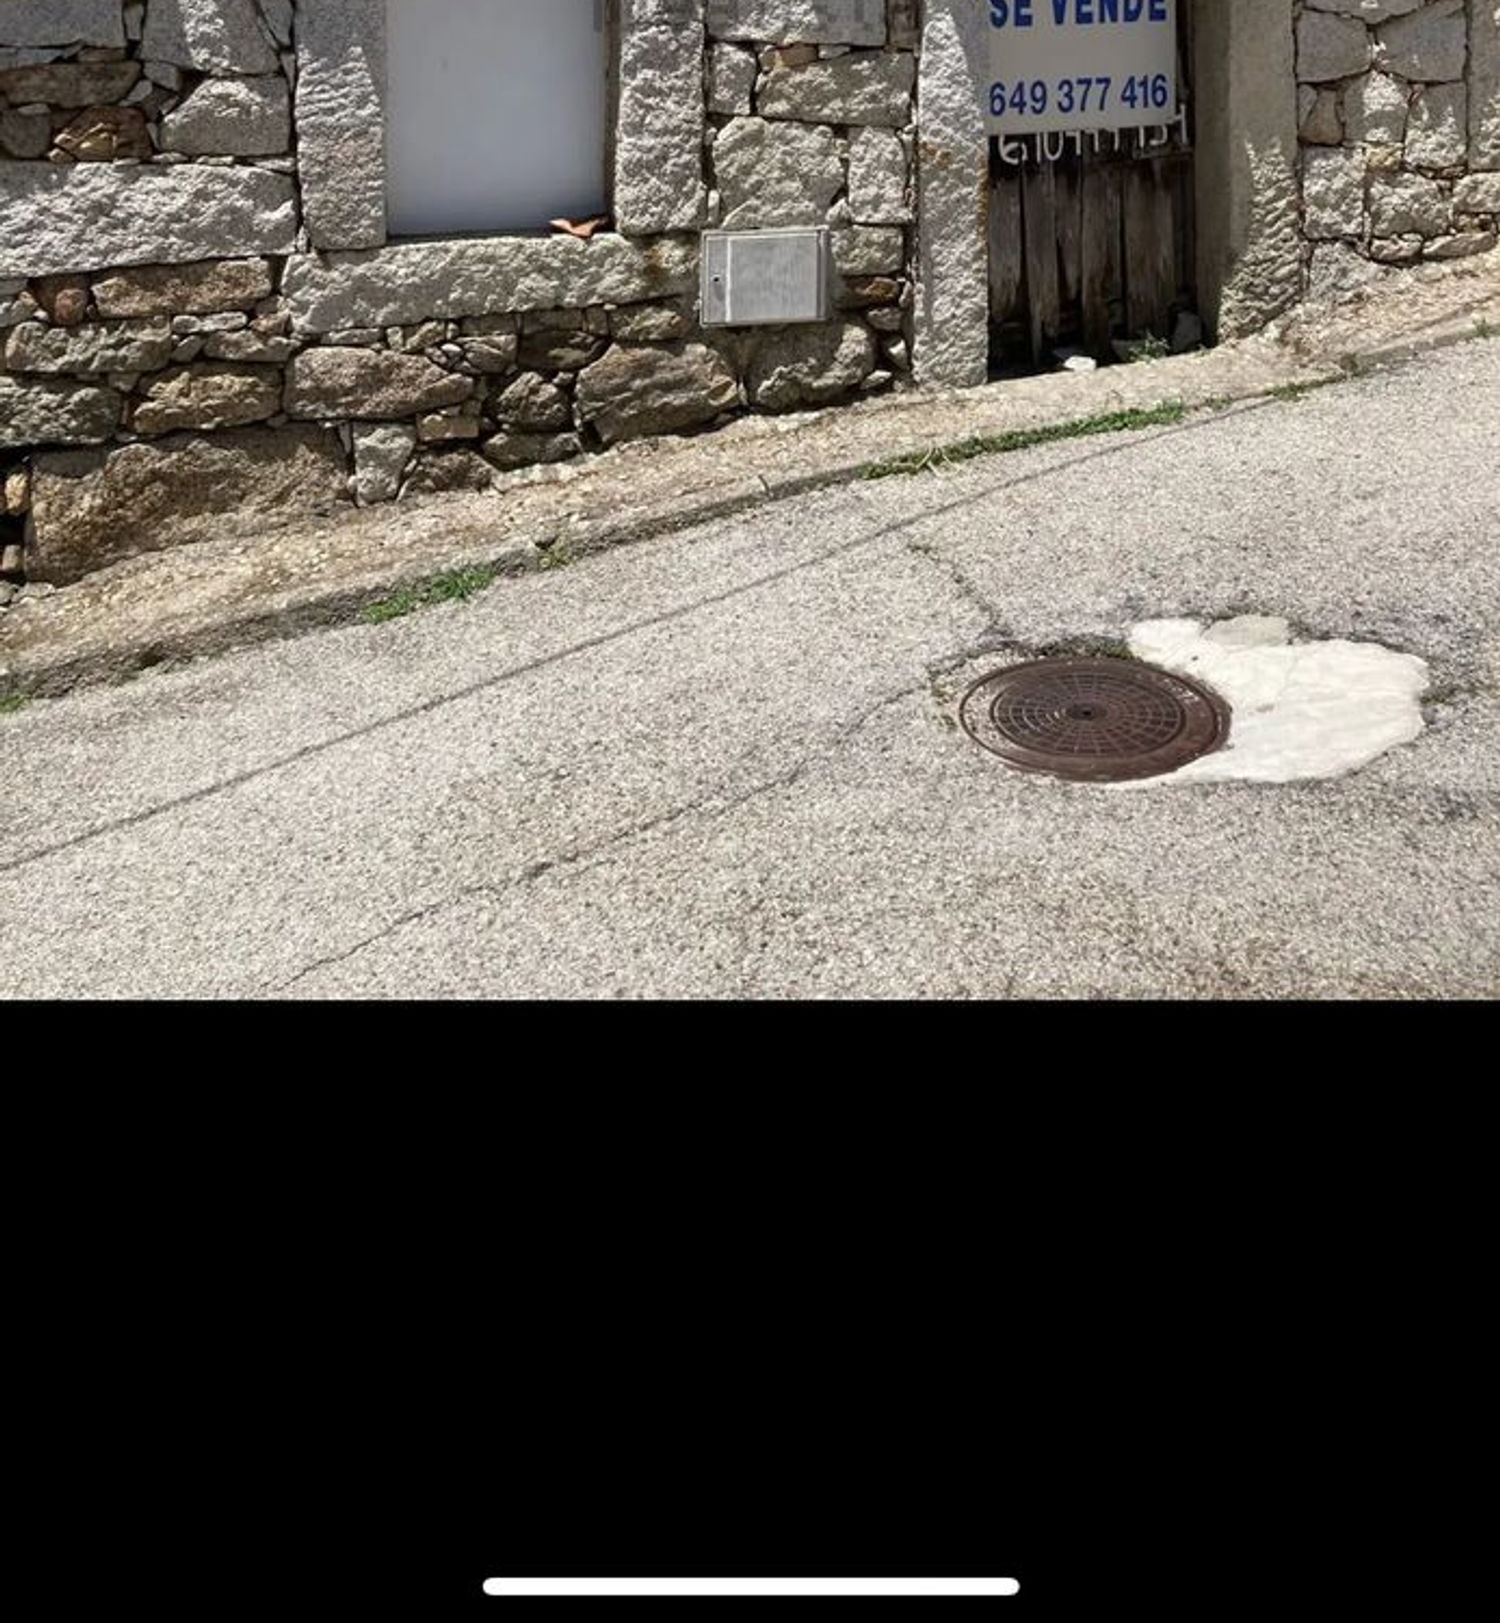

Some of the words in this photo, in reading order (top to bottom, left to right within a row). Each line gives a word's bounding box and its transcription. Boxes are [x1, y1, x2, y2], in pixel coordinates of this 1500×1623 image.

[989, 81, 1047, 117] 649
[1057, 77, 1111, 113] 377
[1121, 74, 1167, 109] 416
